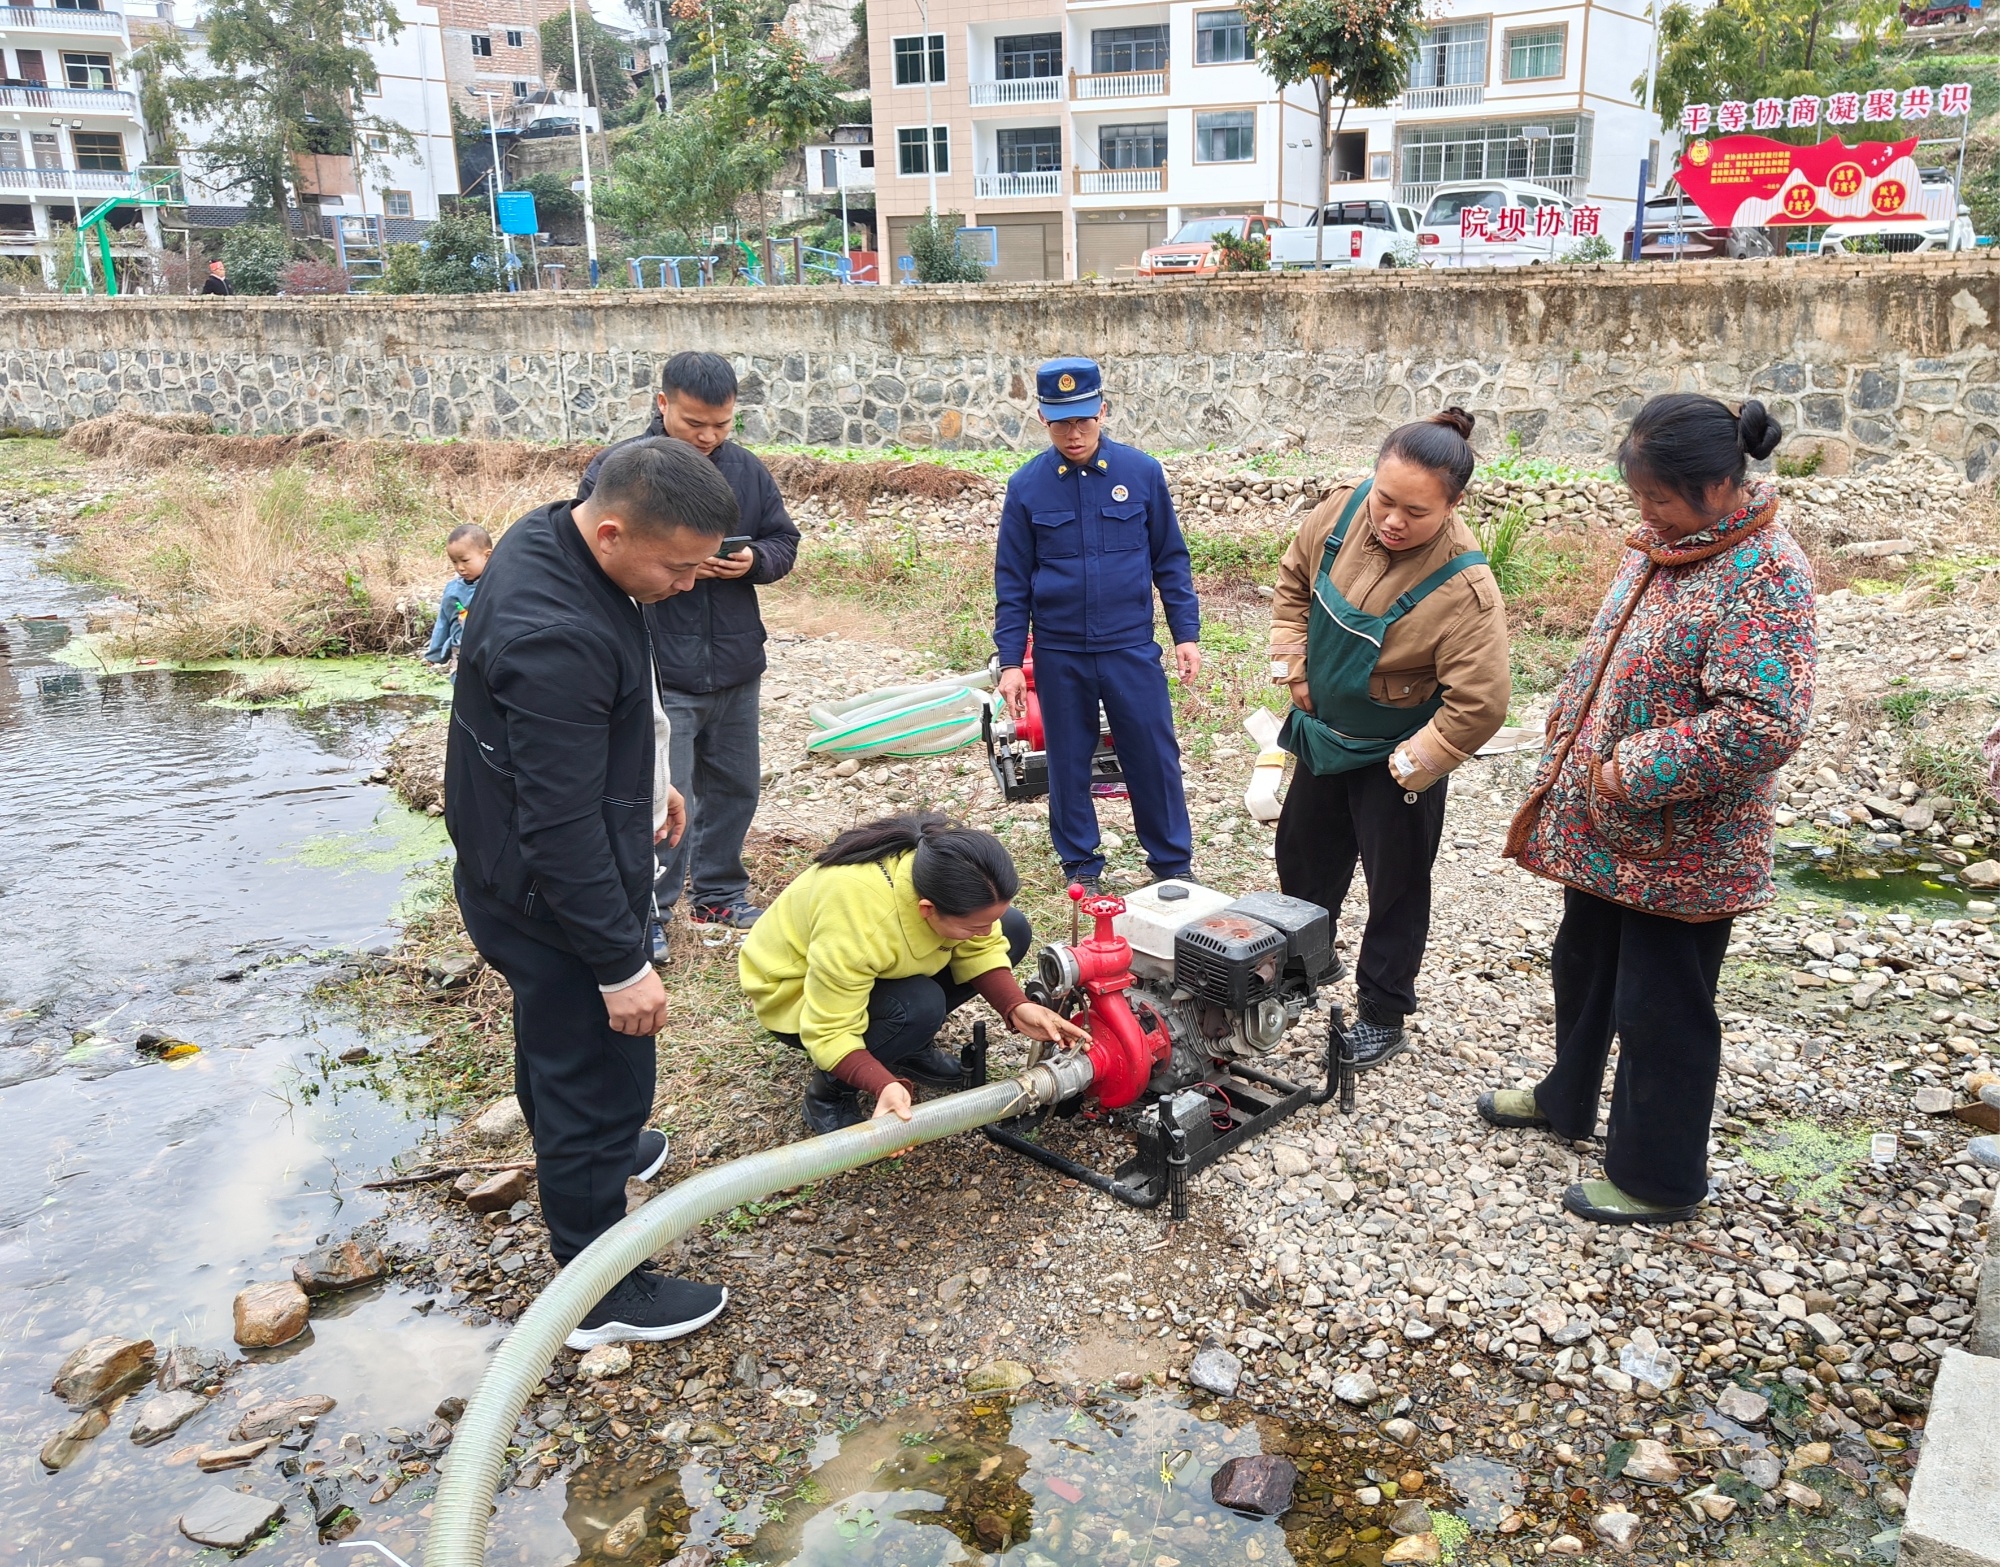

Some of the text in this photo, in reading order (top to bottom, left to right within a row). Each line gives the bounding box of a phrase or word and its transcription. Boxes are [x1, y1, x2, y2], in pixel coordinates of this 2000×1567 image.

[1682, 84, 1972, 132] 平等协商凝聚共识
[1461, 205, 1601, 238] 院坝协商
